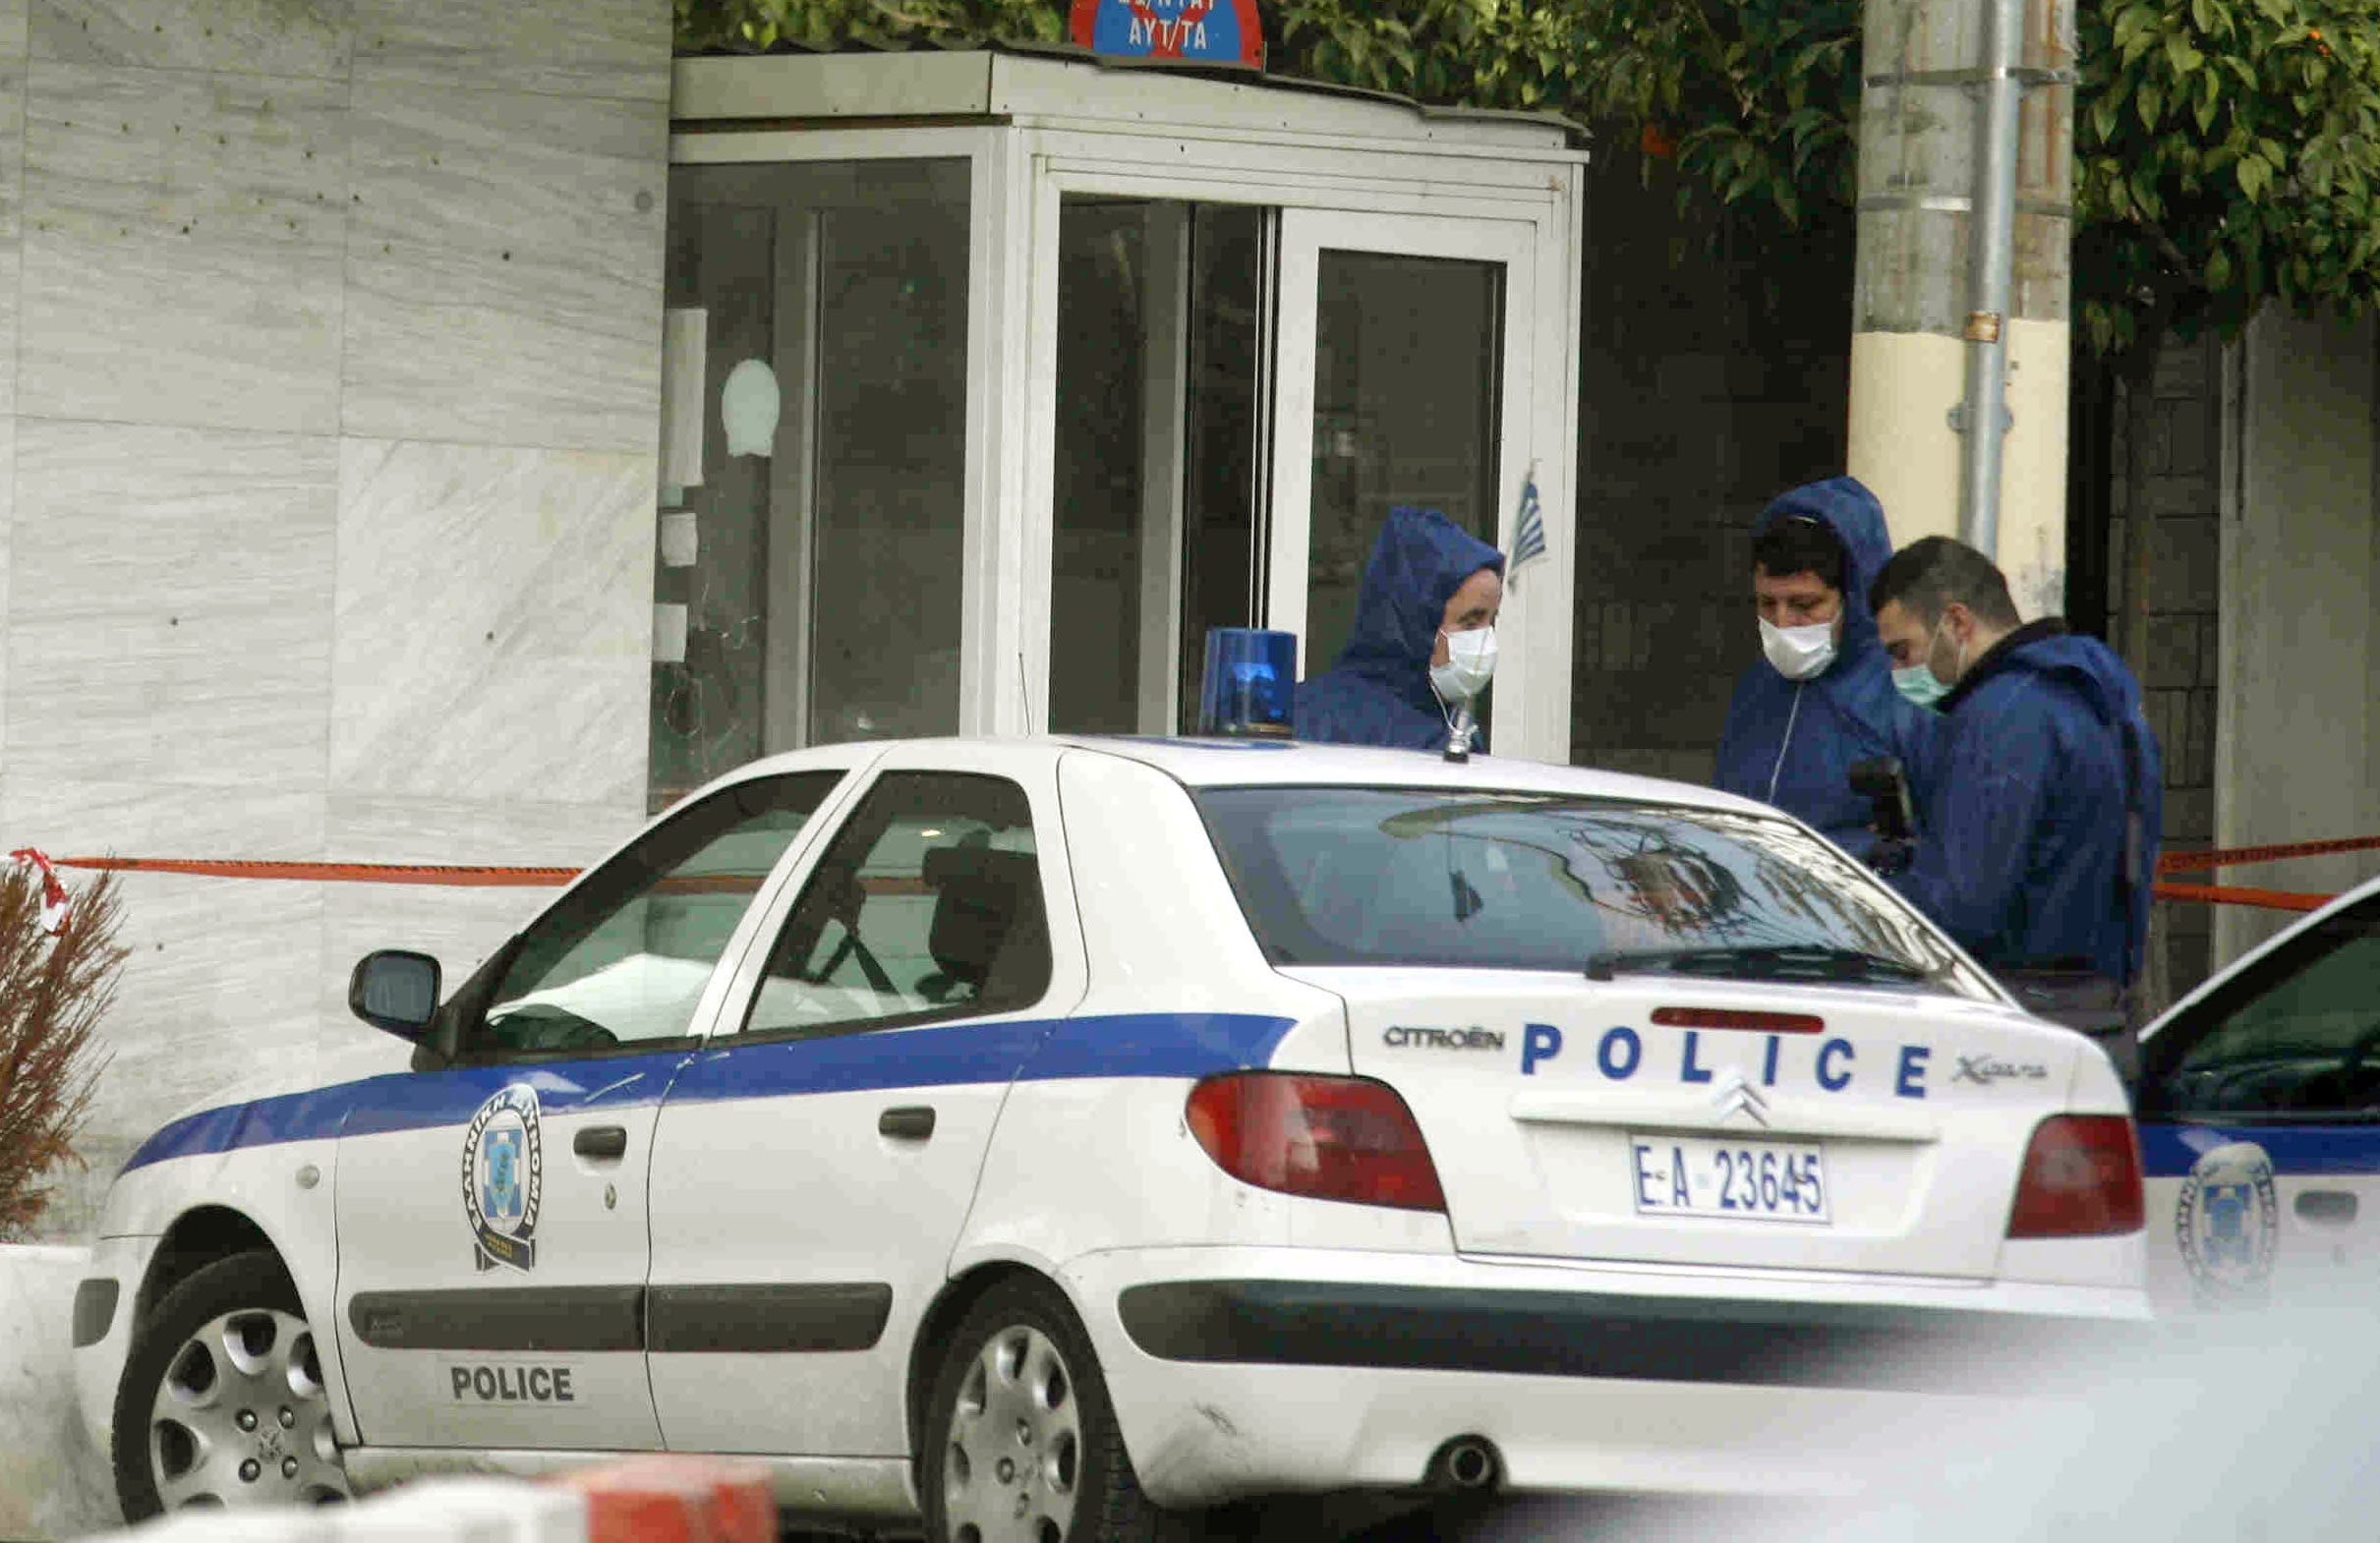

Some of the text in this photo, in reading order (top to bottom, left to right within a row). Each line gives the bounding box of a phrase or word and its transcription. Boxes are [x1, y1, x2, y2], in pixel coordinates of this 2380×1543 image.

[1383, 1025, 1504, 1050] CITROËN
[1521, 1022, 1933, 1099] POLICE
[1714, 1148, 1821, 1214] 23645
[450, 1365, 575, 1401] POLICE
